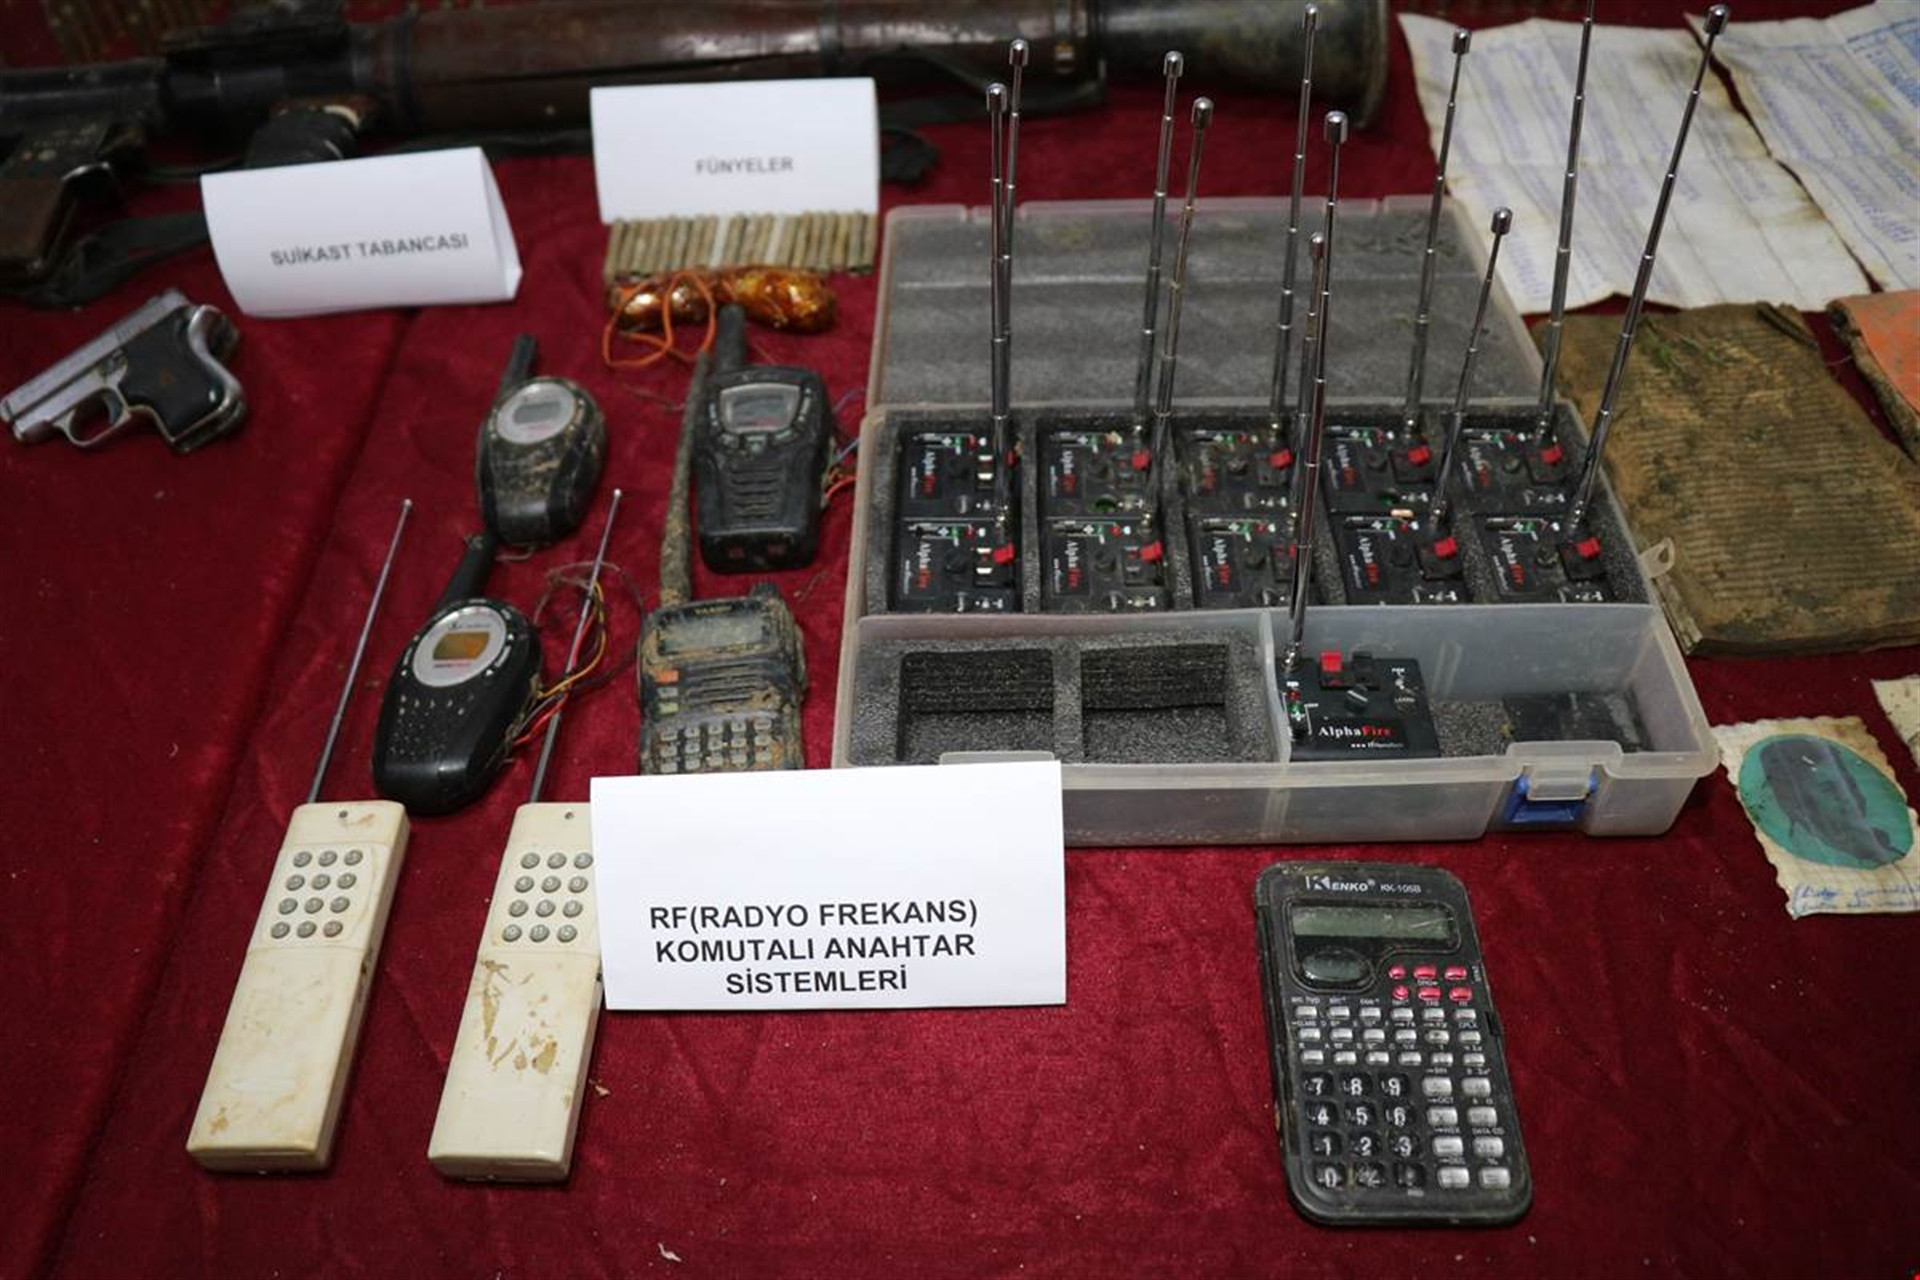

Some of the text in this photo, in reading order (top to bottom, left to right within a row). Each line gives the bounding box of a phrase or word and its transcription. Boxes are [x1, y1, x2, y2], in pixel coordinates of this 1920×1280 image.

[695, 156, 794, 175] FÜNYELER
[270, 233, 470, 267] SUİKAST TABANCASI
[1318, 725, 1392, 739] AlphaFire
[650, 898, 978, 934] RF(RADYO FREKANS)
[655, 933, 976, 964] KOMUTALI ANAHTAR
[725, 964, 908, 995] SİSTEMLERİ
